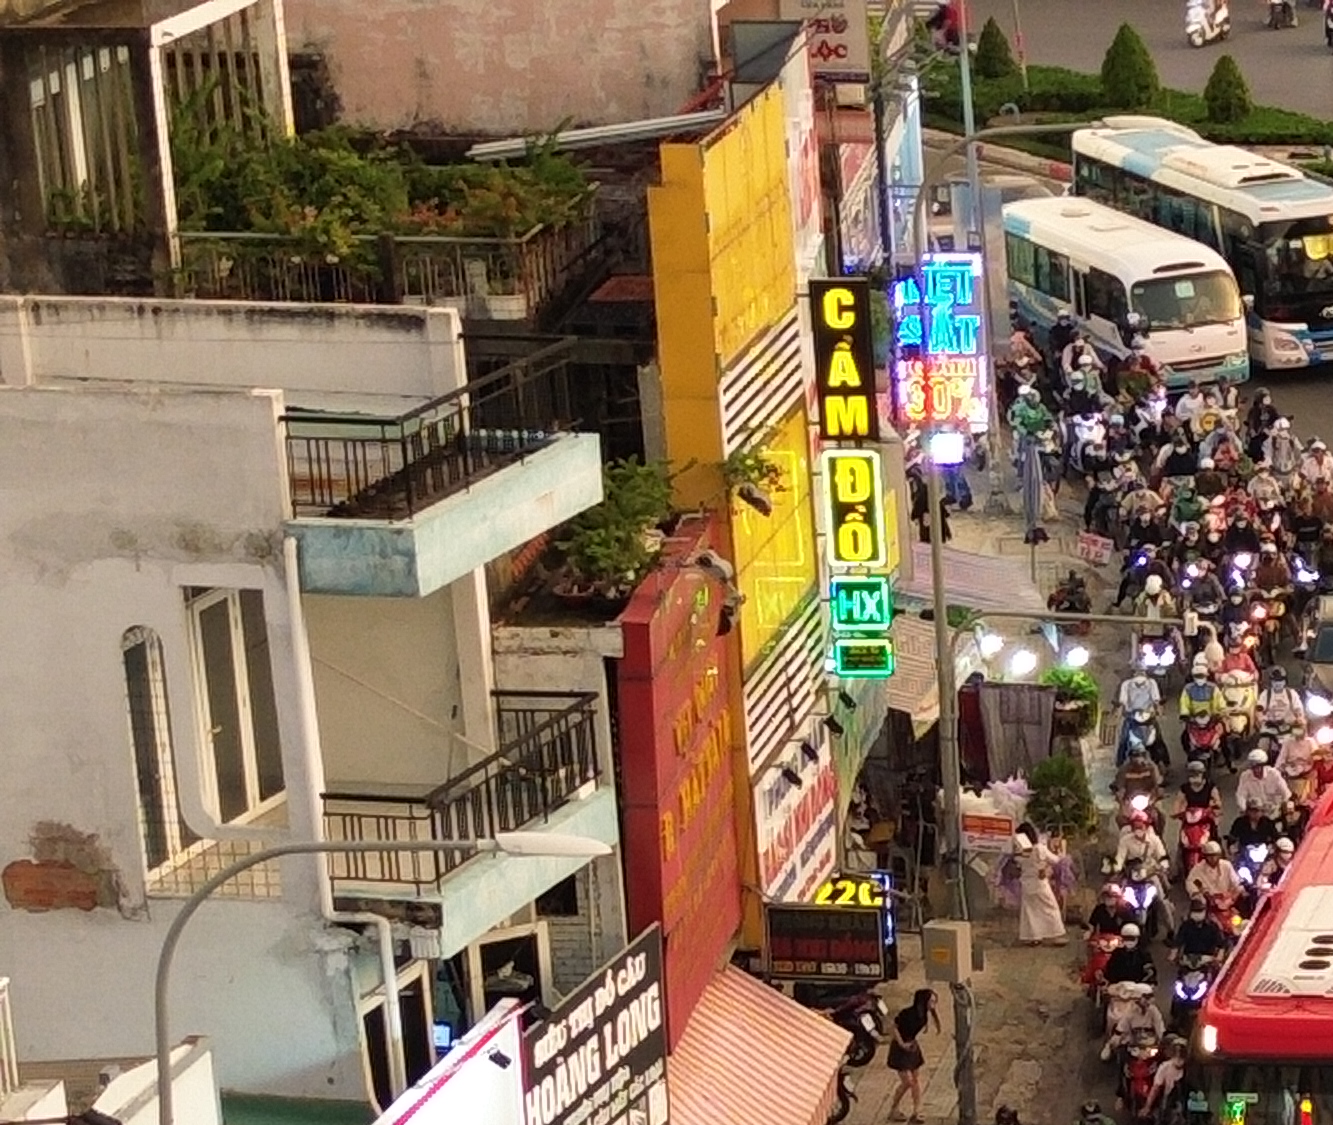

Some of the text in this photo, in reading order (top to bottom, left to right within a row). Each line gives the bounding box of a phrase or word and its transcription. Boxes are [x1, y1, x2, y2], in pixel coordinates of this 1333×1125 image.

[823, 288, 868, 436] CẦM
[835, 457, 874, 561] ĐỒ
[839, 589, 881, 621] HX
[603, 981, 661, 1071] LONG
